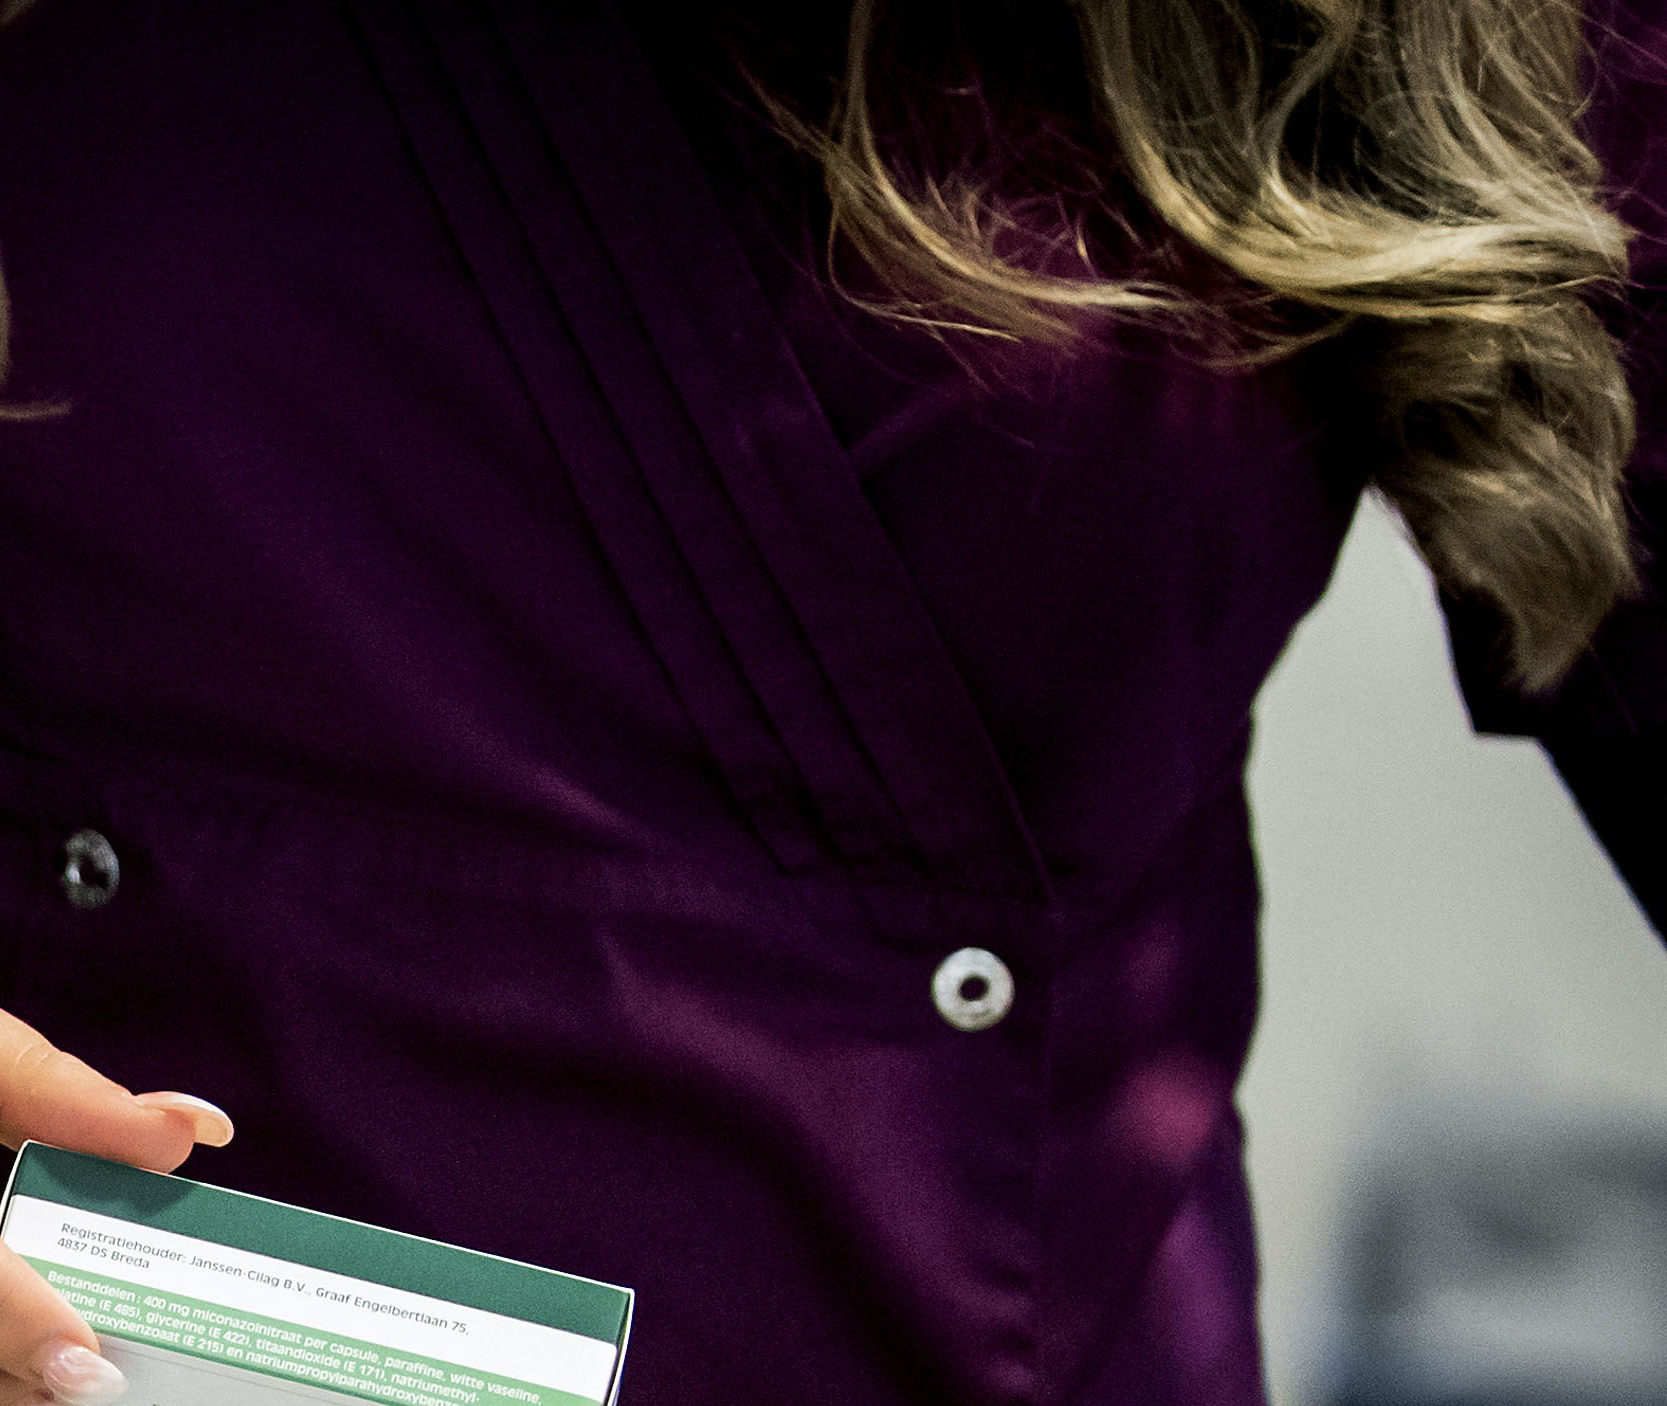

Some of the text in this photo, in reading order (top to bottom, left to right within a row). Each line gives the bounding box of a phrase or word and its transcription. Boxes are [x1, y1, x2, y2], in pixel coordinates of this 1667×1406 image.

[57, 1236, 150, 1269] 4837 DS Breda
[61, 1222, 187, 1263] Registratiehouder:
[189, 1255, 279, 1287] Janssen-Cilag
[316, 1286, 351, 1304] Graaf
[354, 1296, 448, 1329] Engelbertlaan
[143, 1294, 166, 1310] 400
[168, 1301, 191, 1317] mg
[193, 1305, 301, 1344] miconazolnitraat
[304, 1336, 328, 1353] per
[330, 1341, 381, 1366] capsule,
[384, 1355, 446, 1382] paraffine,
[450, 1371, 485, 1390] witte
[146, 1311, 205, 1335] glycerine
[256, 1338, 341, 1369] titaandioxide
[198, 1338, 224, 1355] 215)
[227, 1345, 243, 1359] en
